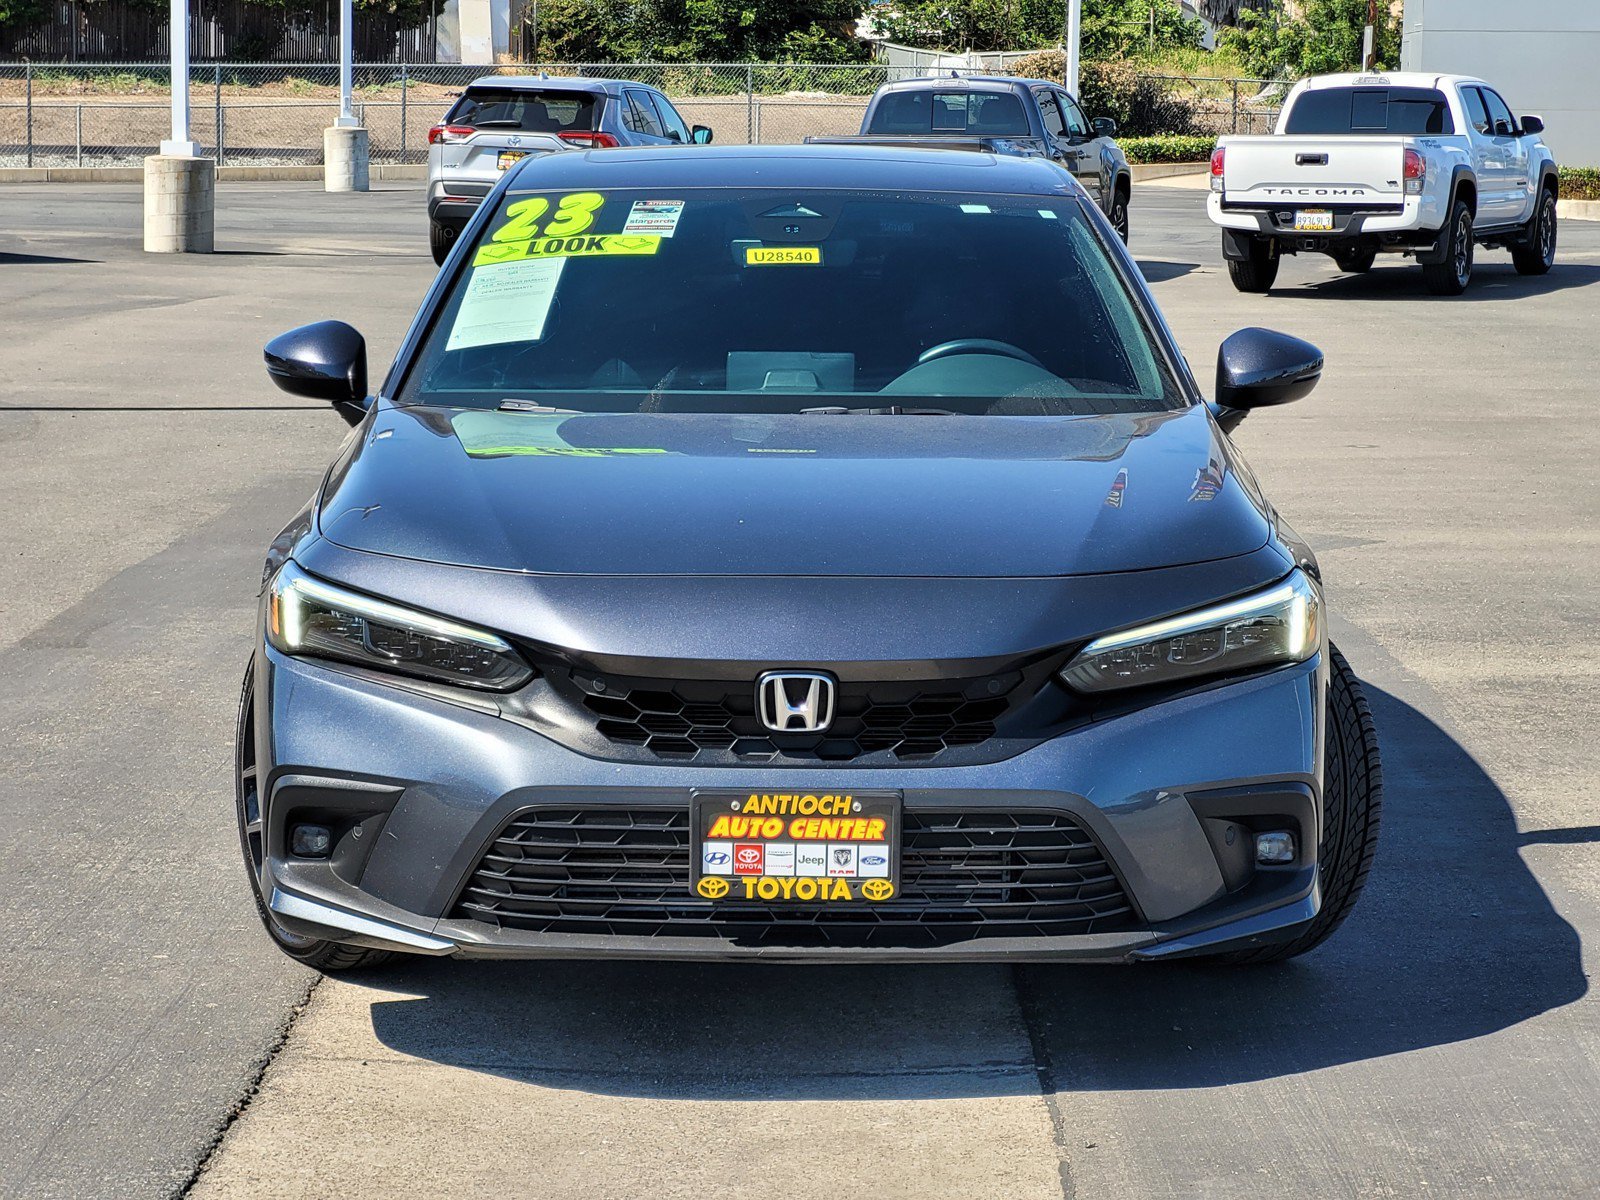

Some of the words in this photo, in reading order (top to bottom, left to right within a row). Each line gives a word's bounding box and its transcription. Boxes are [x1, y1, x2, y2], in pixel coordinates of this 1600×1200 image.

[491, 192, 605, 243] 23
[525, 236, 609, 256] LOOK
[754, 251, 813, 262] U28540
[742, 794, 853, 815] ANTIOCH
[707, 815, 785, 839] AUTO
[788, 817, 887, 841] CENTER
[798, 855, 825, 866] Jeep
[742, 876, 853, 901] TOYOTA
